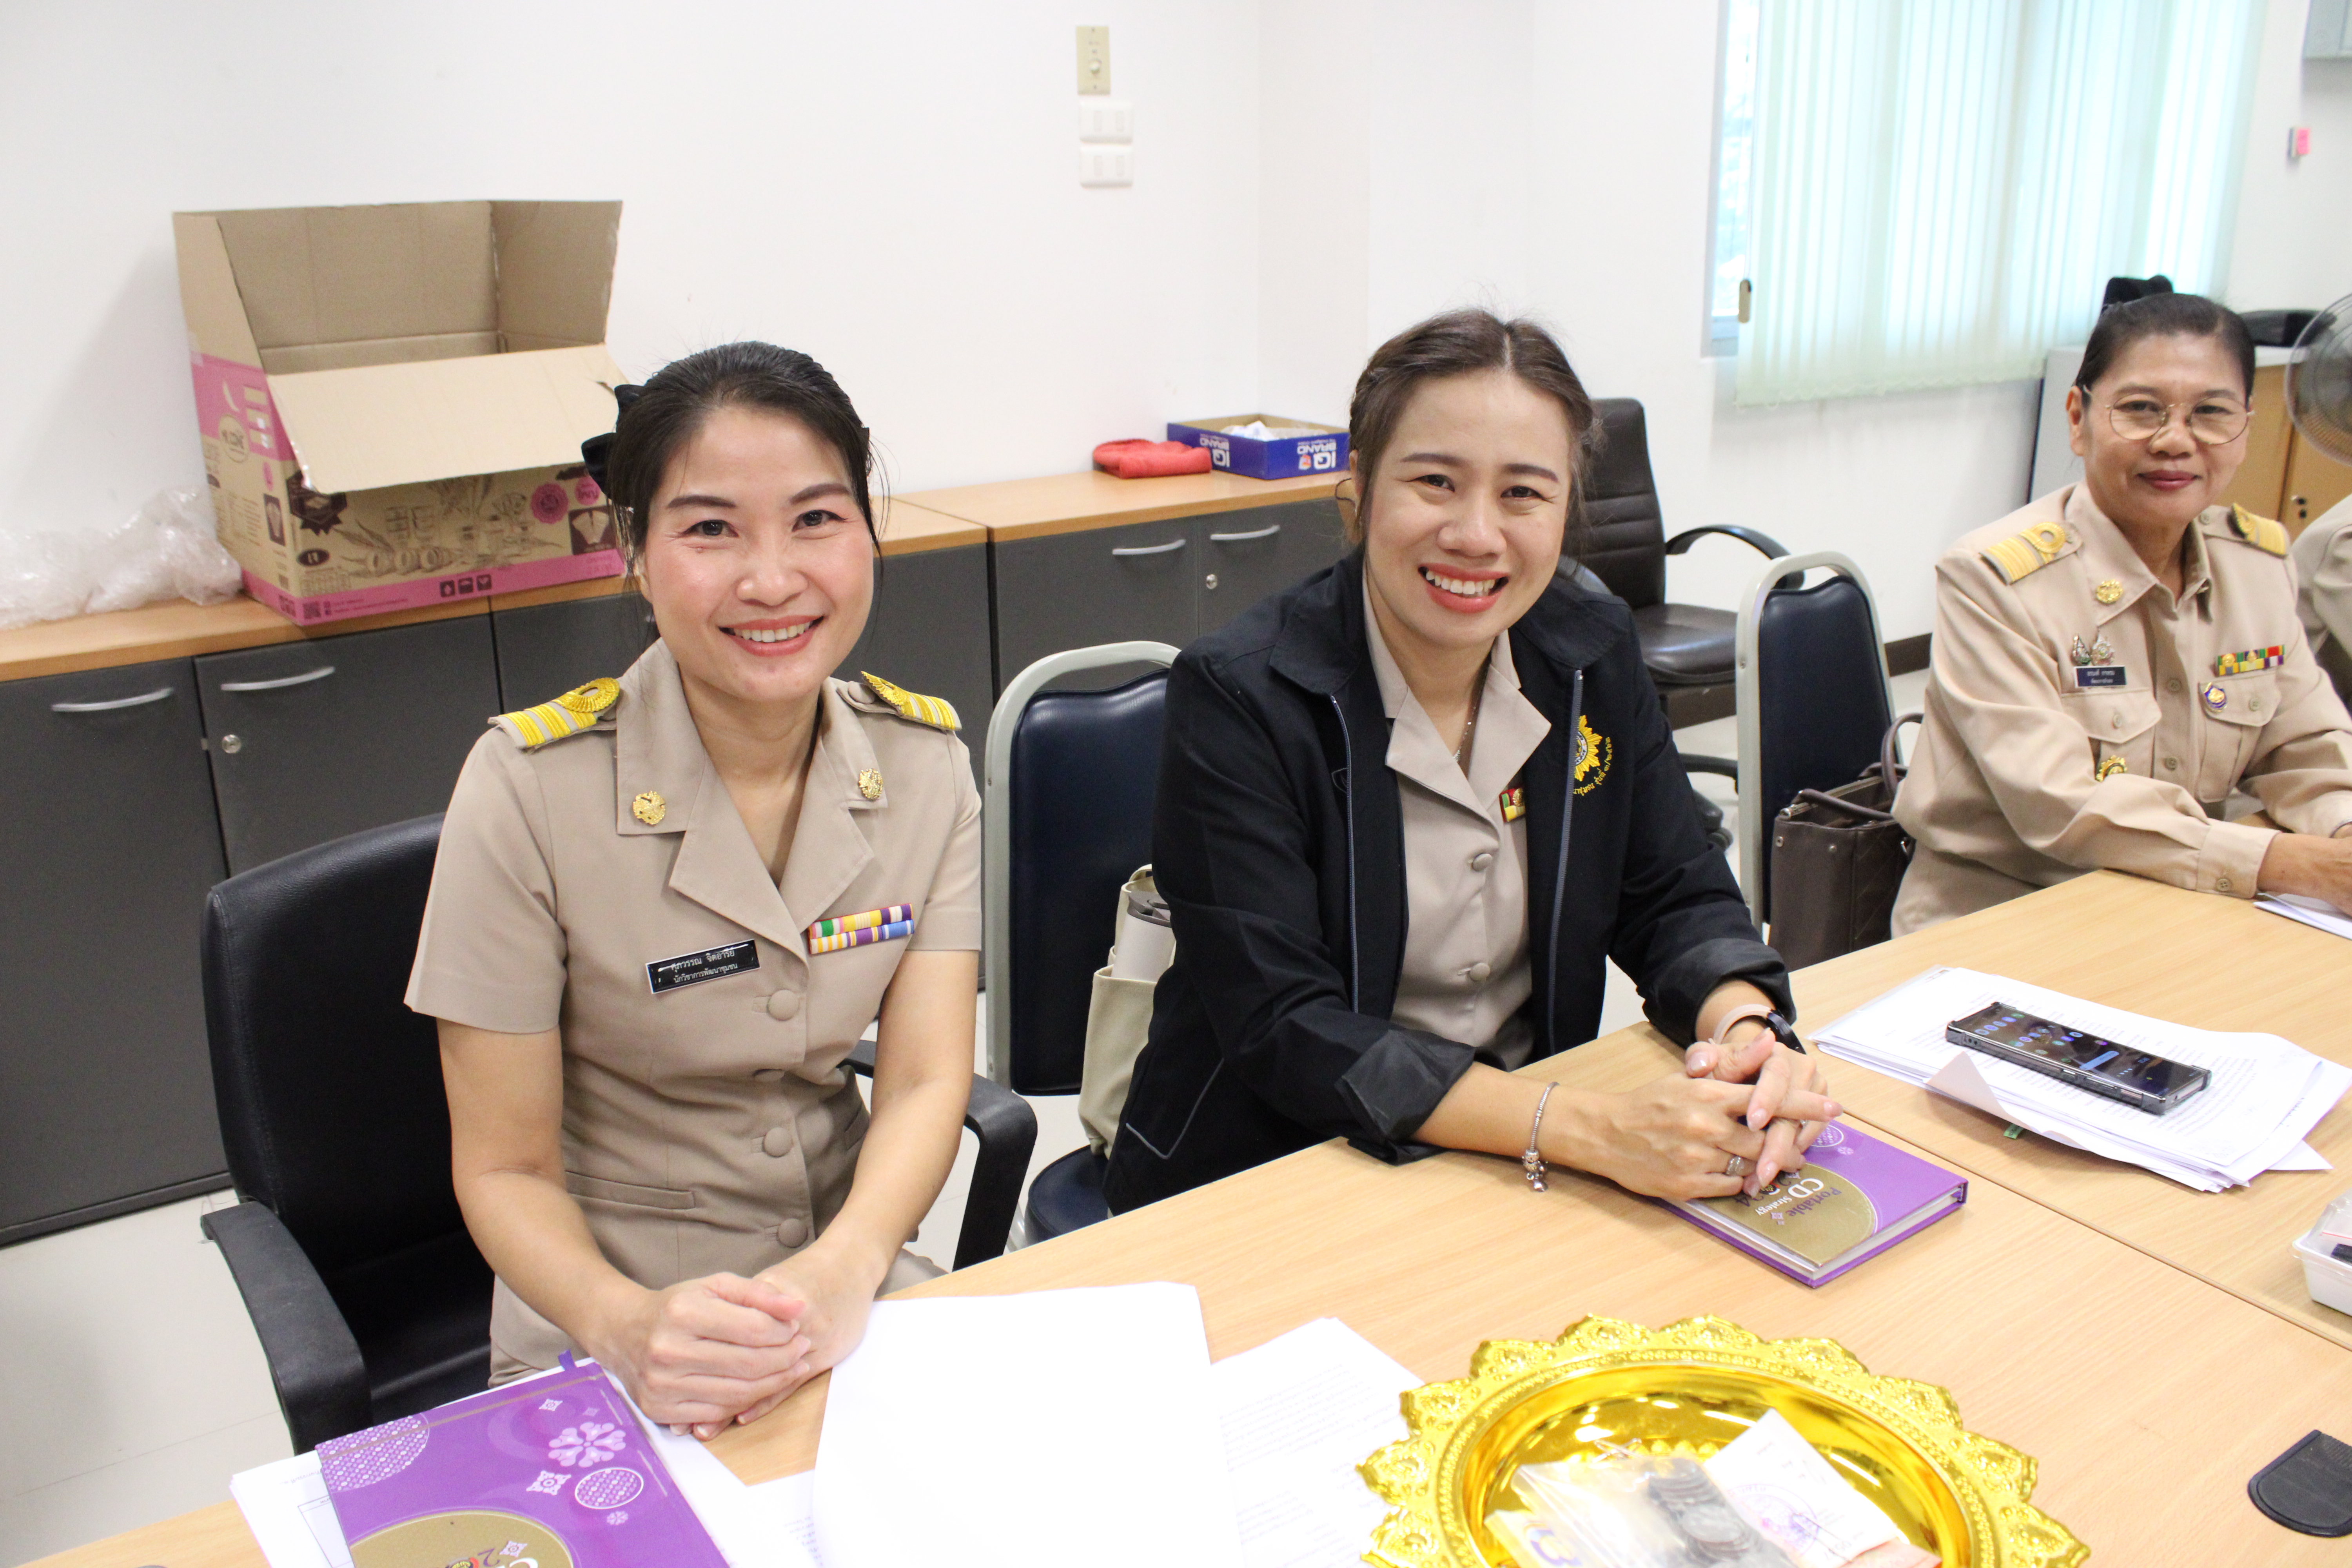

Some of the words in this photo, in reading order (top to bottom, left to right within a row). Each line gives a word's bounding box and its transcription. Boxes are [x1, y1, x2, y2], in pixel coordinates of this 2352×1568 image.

[1200, 437, 1229, 451] BRAND
[1297, 442, 1336, 454] BRAND
[1212, 448, 1230, 467] IQ
[1313, 451, 1336, 470] IQ
[673, 963, 738, 983] นักวิชาการพัฒนาชุมชน
[1788, 1178, 1824, 1198] CD
[1755, 1196, 1792, 1216] Strategy
[1786, 1187, 1842, 1216] Portable
